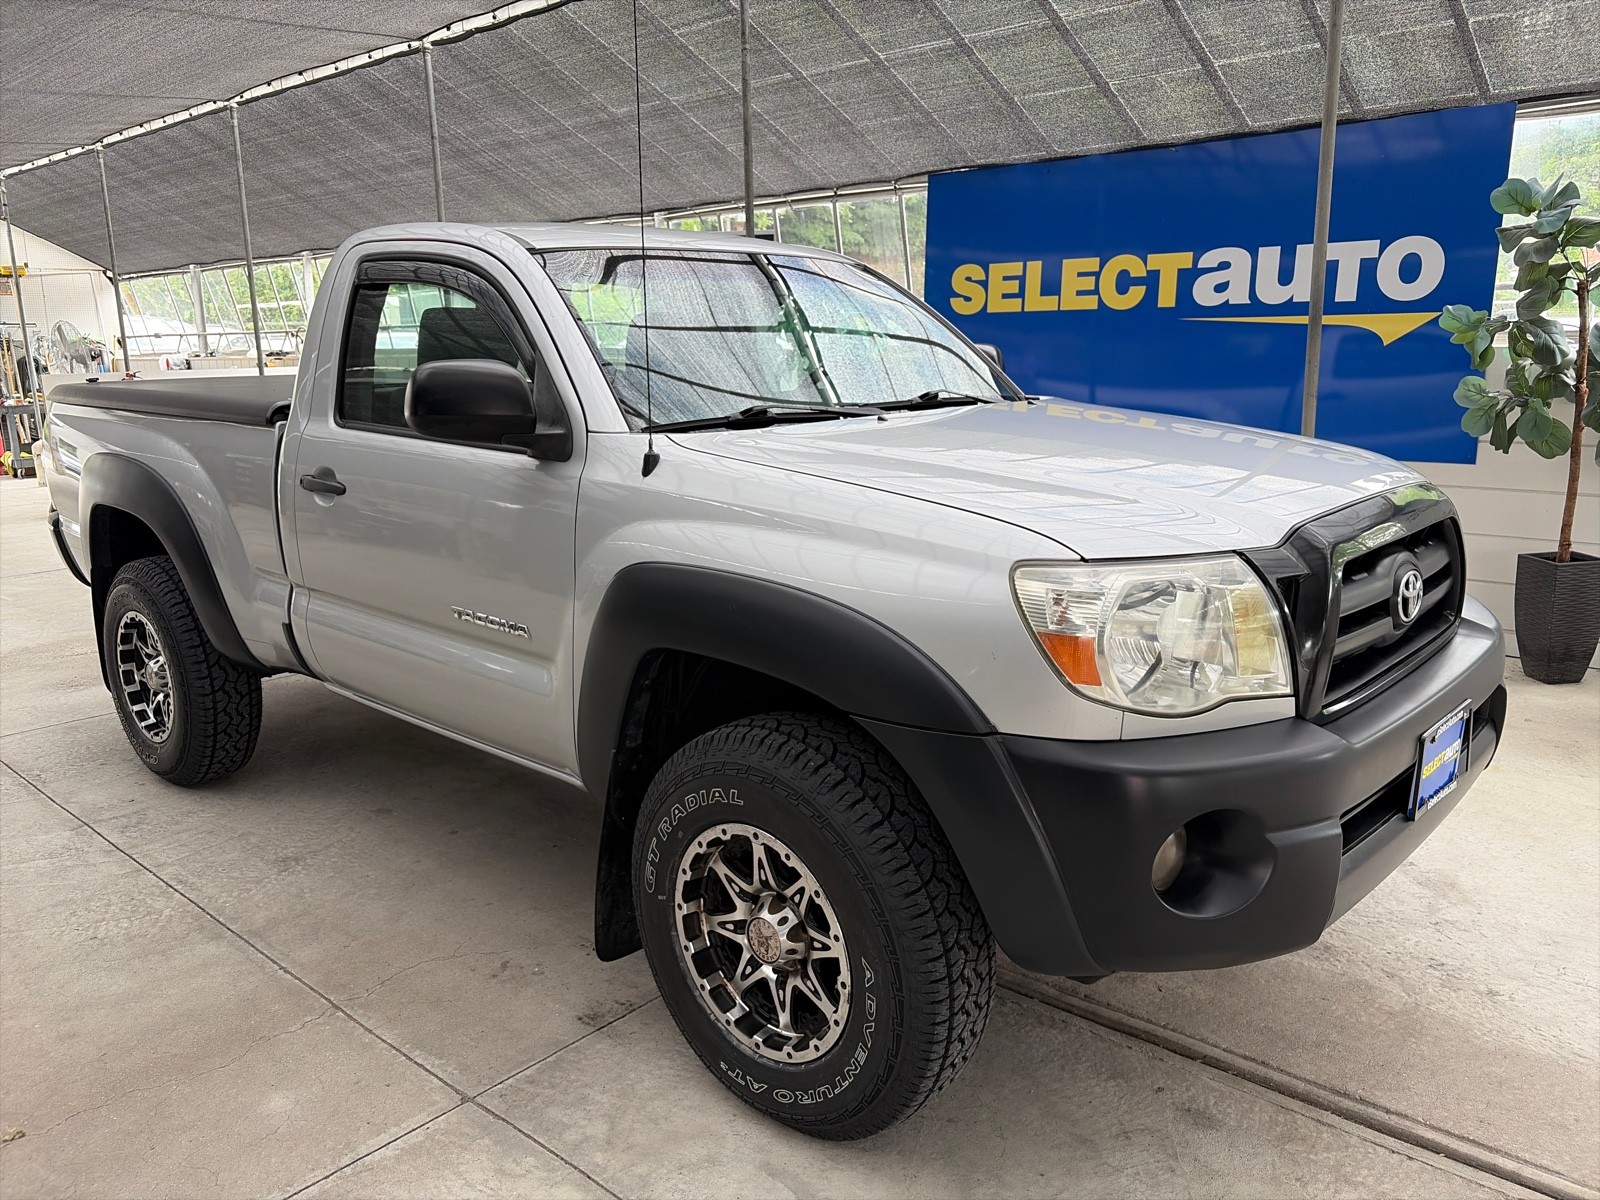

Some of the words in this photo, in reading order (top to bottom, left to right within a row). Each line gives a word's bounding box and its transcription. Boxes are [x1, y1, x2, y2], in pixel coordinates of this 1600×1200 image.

[451, 605, 532, 639] TACOMA
[645, 837, 660, 893] GT
[657, 788, 744, 841] RADIAL
[773, 957, 877, 1104] ADVENTURO
